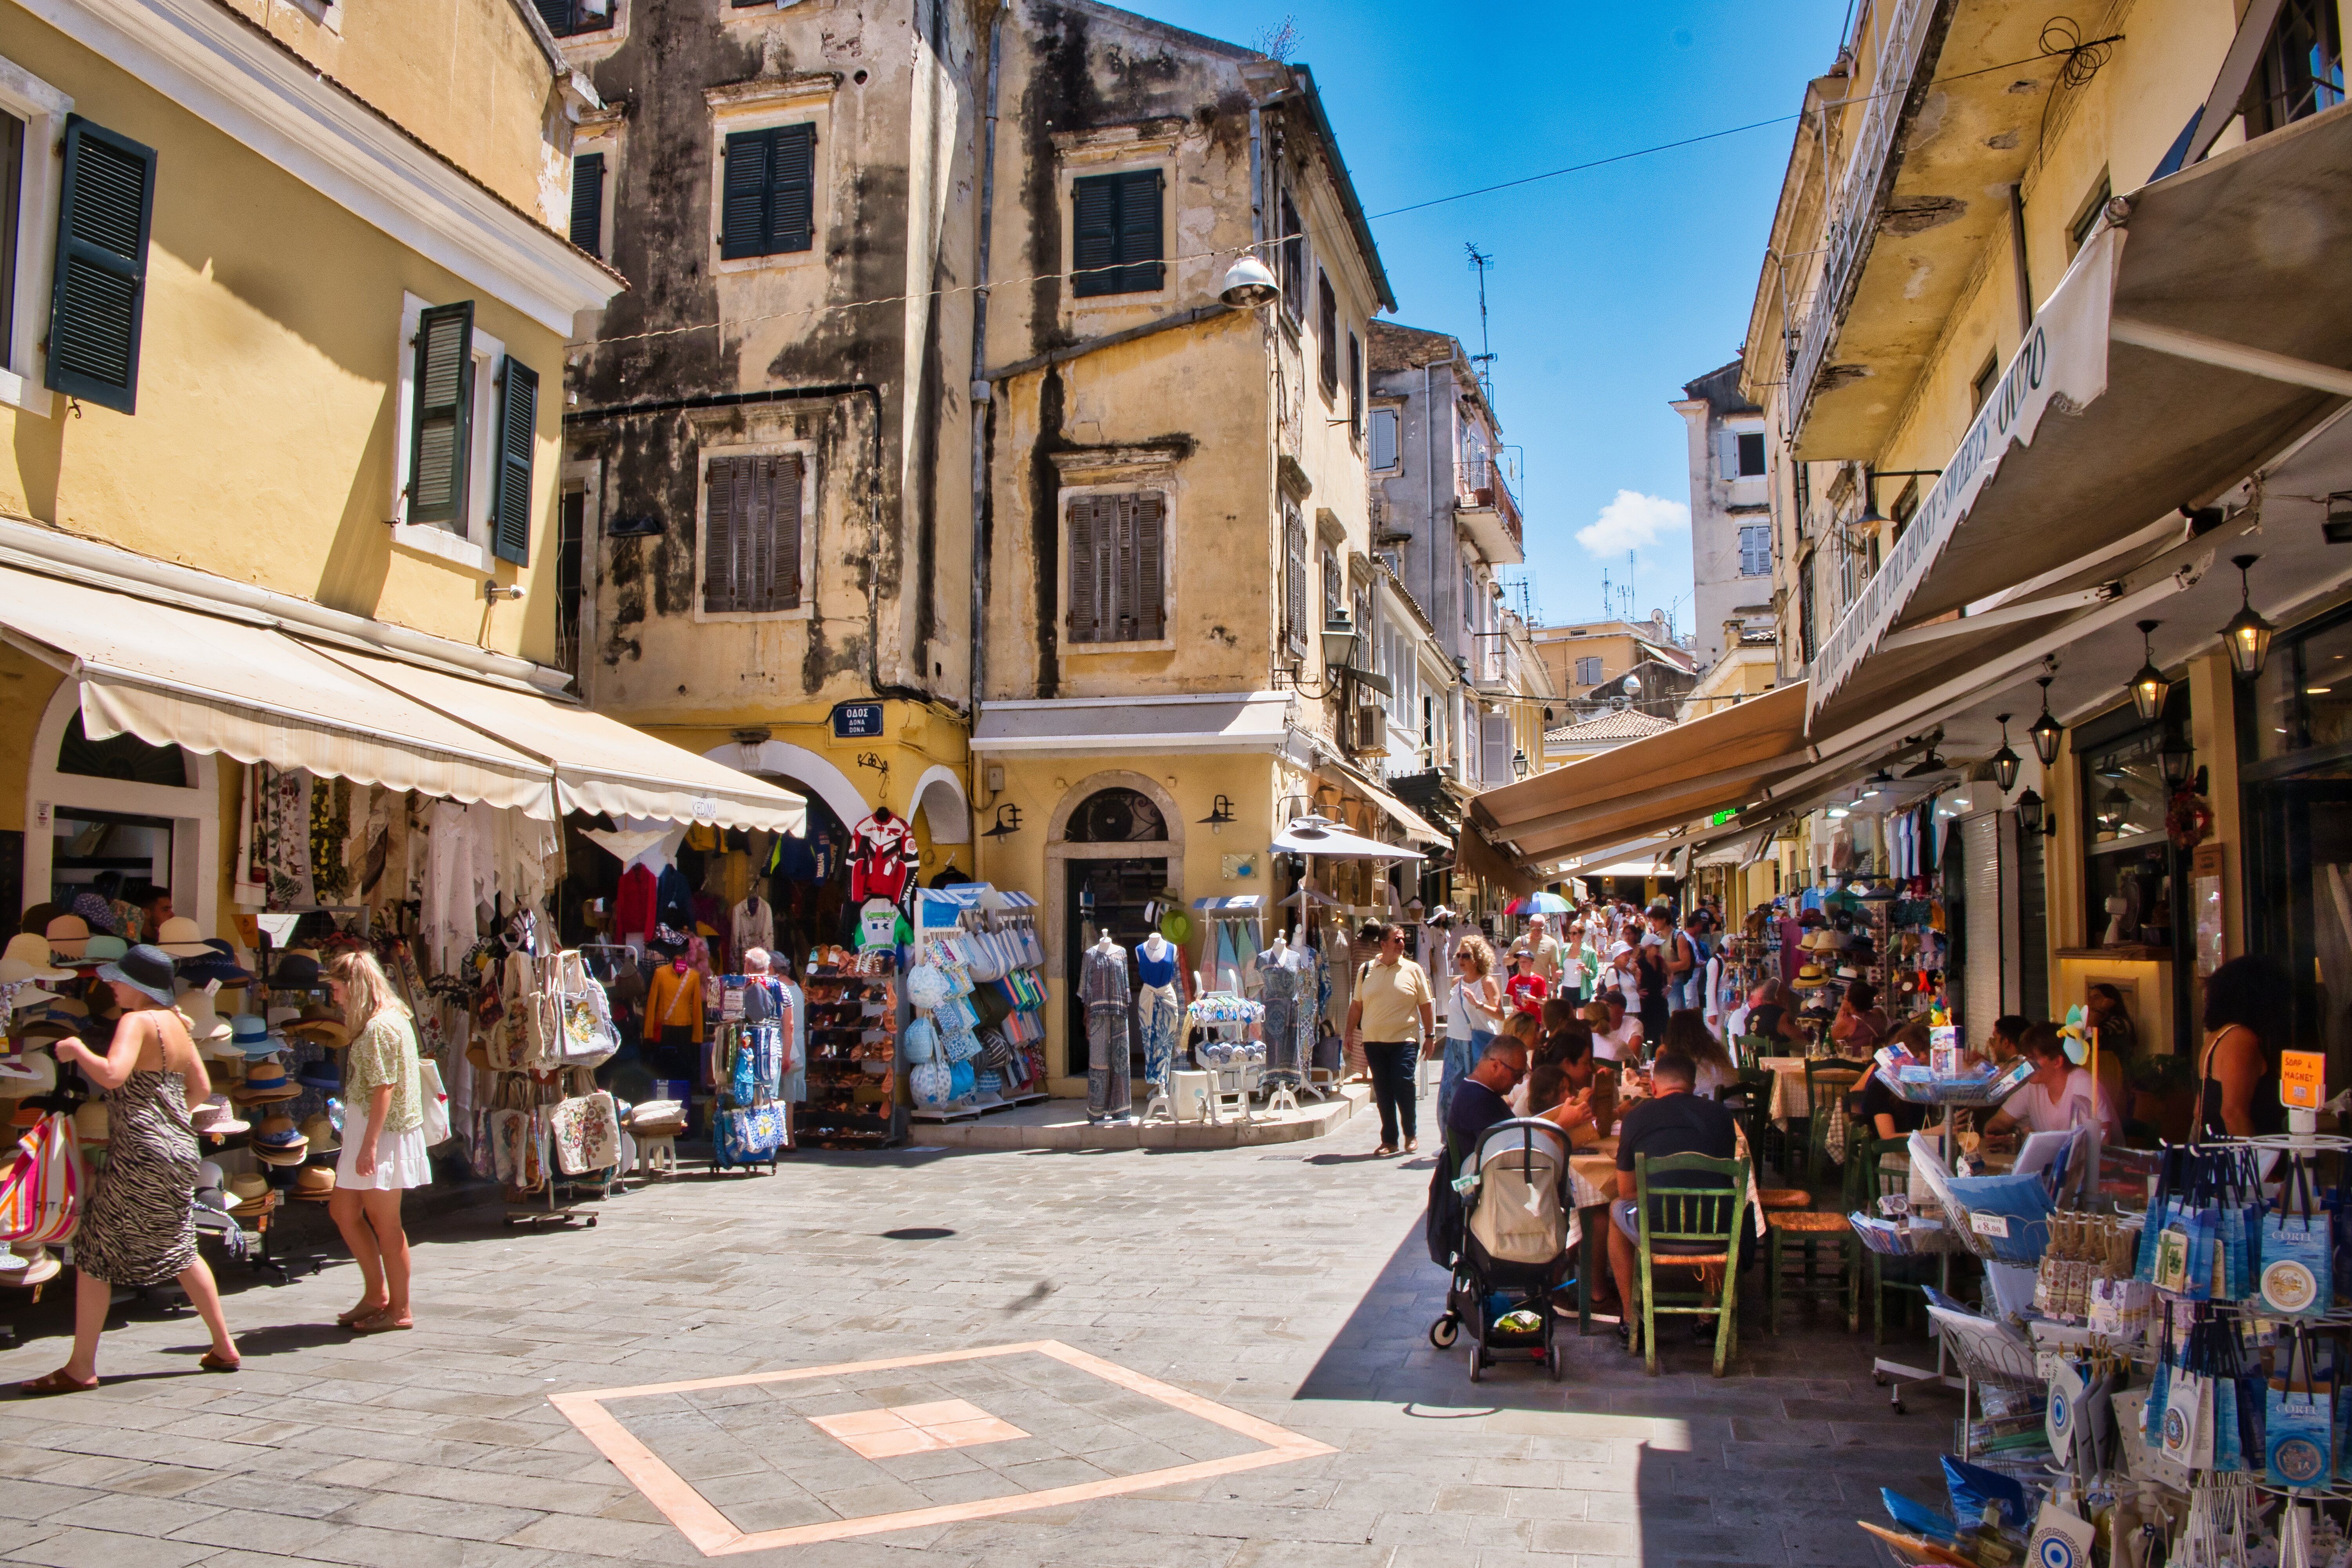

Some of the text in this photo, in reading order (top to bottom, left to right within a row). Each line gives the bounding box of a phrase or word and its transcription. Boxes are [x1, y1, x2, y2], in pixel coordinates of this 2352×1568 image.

[1846, 599, 1865, 654] OLIVE
[1866, 581, 1880, 628] OIL
[1884, 541, 1905, 606] PURE
[1906, 487, 1938, 573] HONEY
[1942, 407, 1990, 520] SWEETS
[1998, 326, 2046, 436] OUZO
[847, 708, 868, 718] ΟΔΟΣ
[2284, 1071, 2313, 1082] MAGNET
[1983, 1222, 2001, 1233] 8.00
